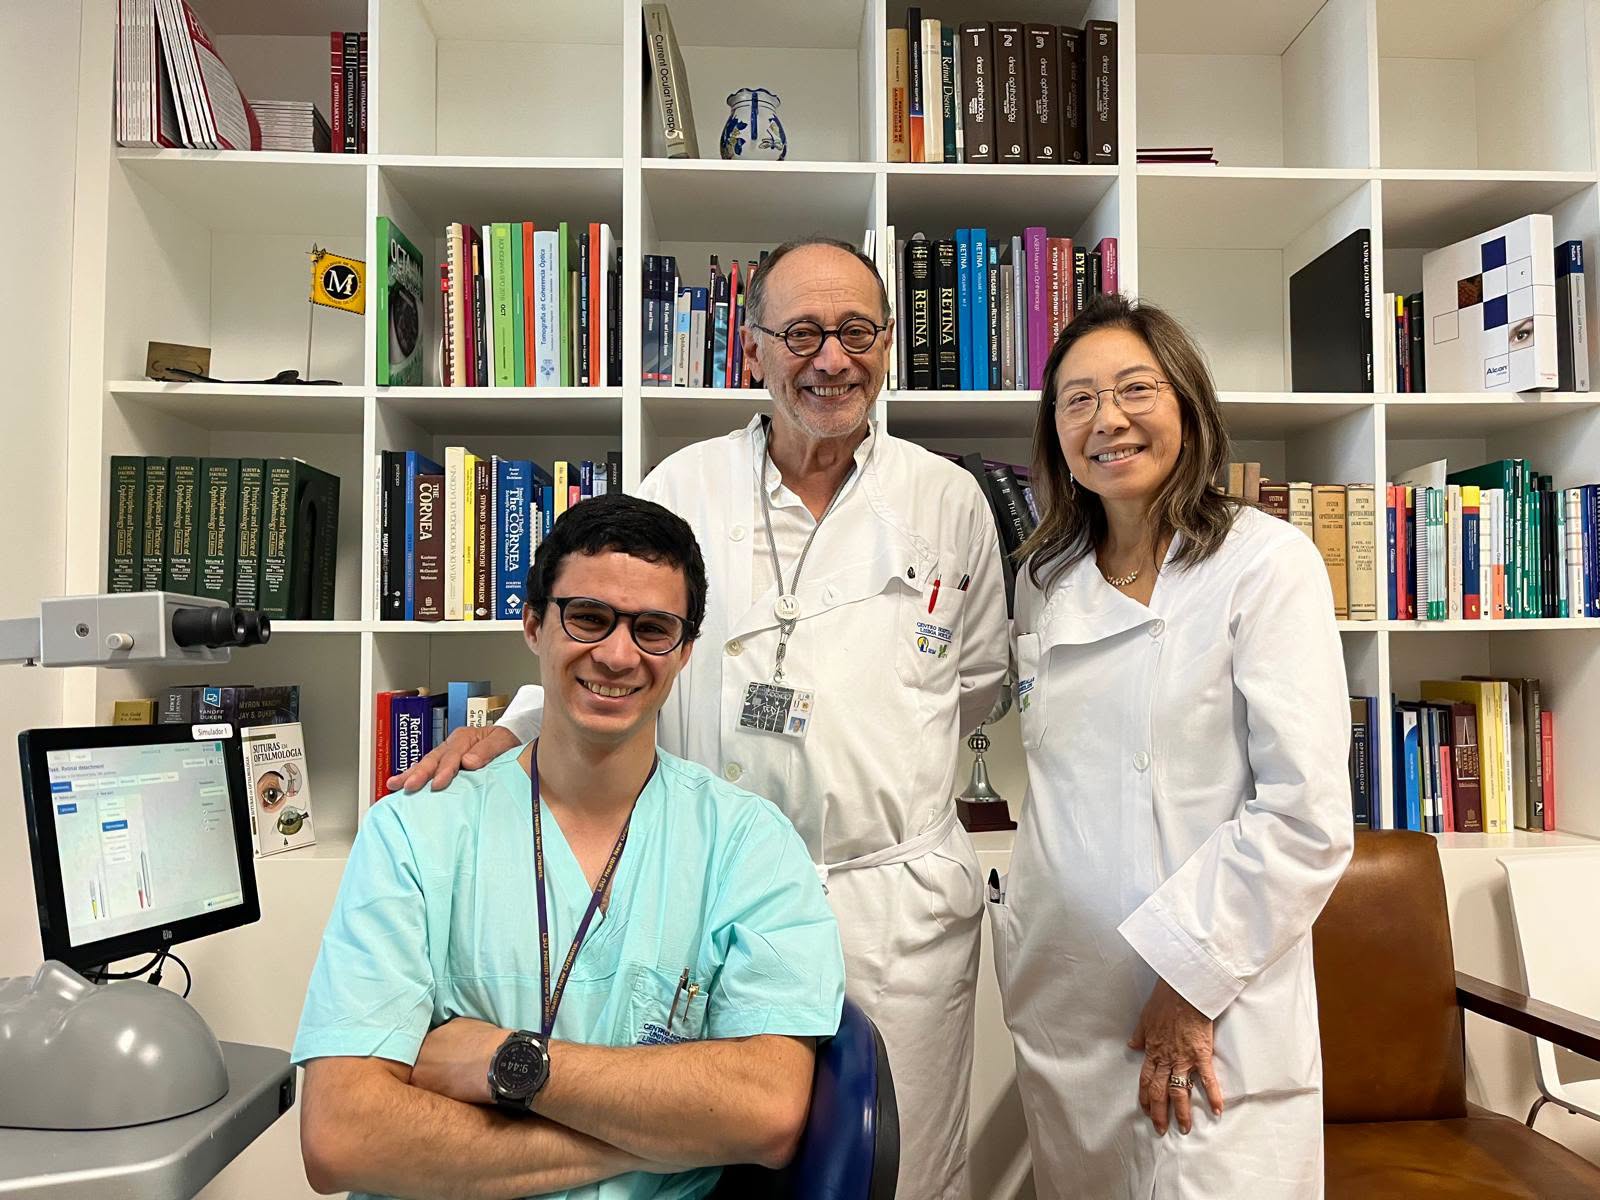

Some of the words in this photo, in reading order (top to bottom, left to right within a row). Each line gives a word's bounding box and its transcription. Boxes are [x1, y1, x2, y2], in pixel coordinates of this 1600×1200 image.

[655, 34, 667, 66] Current
[973, 34, 979, 47] 1
[1004, 34, 1013, 47] 2
[1035, 36, 1044, 48] 3
[1099, 33, 1108, 46] 5
[660, 68, 671, 97] Ocular
[976, 76, 985, 123] ophthalmology
[1007, 76, 1016, 123] ophthalmology
[1040, 77, 1048, 124] ophthalmology
[1100, 75, 1110, 121] ophthalmology
[665, 99, 676, 132] Therapy
[1075, 252, 1085, 274] EYE
[327, 270, 354, 295] M
[915, 289, 927, 347] RETINA
[941, 287, 953, 345] RETINA
[1486, 365, 1508, 375] Alcon
[116, 484, 126, 528] Ophthalmology
[126, 485, 135, 513] Principles
[144, 484, 155, 528] Ophthalmology
[155, 485, 164, 513] Principles
[173, 484, 184, 528] Ophthalmology
[184, 485, 193, 513] Principles
[207, 486, 218, 530] Ophthalmology
[217, 486, 227, 515] Principles
[240, 486, 251, 530] Ophthalmology
[250, 487, 260, 515] Principles
[268, 487, 280, 531] Ophthalmology
[278, 487, 289, 517] Principles
[419, 482, 433, 541] CORNEA
[509, 488, 519, 512] The
[1007, 500, 1017, 516] THE
[126, 526, 134, 548] Practice
[154, 527, 162, 548] Practice
[183, 526, 191, 548] Practice
[218, 527, 226, 549] Practice
[250, 527, 258, 550] Practice
[278, 527, 286, 550] Practice
[509, 513, 520, 572] CORNEA
[478, 574, 486, 603] DISTROFIAS
[505, 607, 521, 615] LWW
[238, 712, 249, 720] JAY
[469, 710, 476, 718] de
[197, 728, 224, 736] Simulador
[397, 713, 410, 772] Keratotomy
[252, 742, 281, 754] SUTURAS
[253, 748, 302, 763] OFTALMOLOGIA
[556, 972, 567, 991] New
[507, 1061, 529, 1074] 9:44
